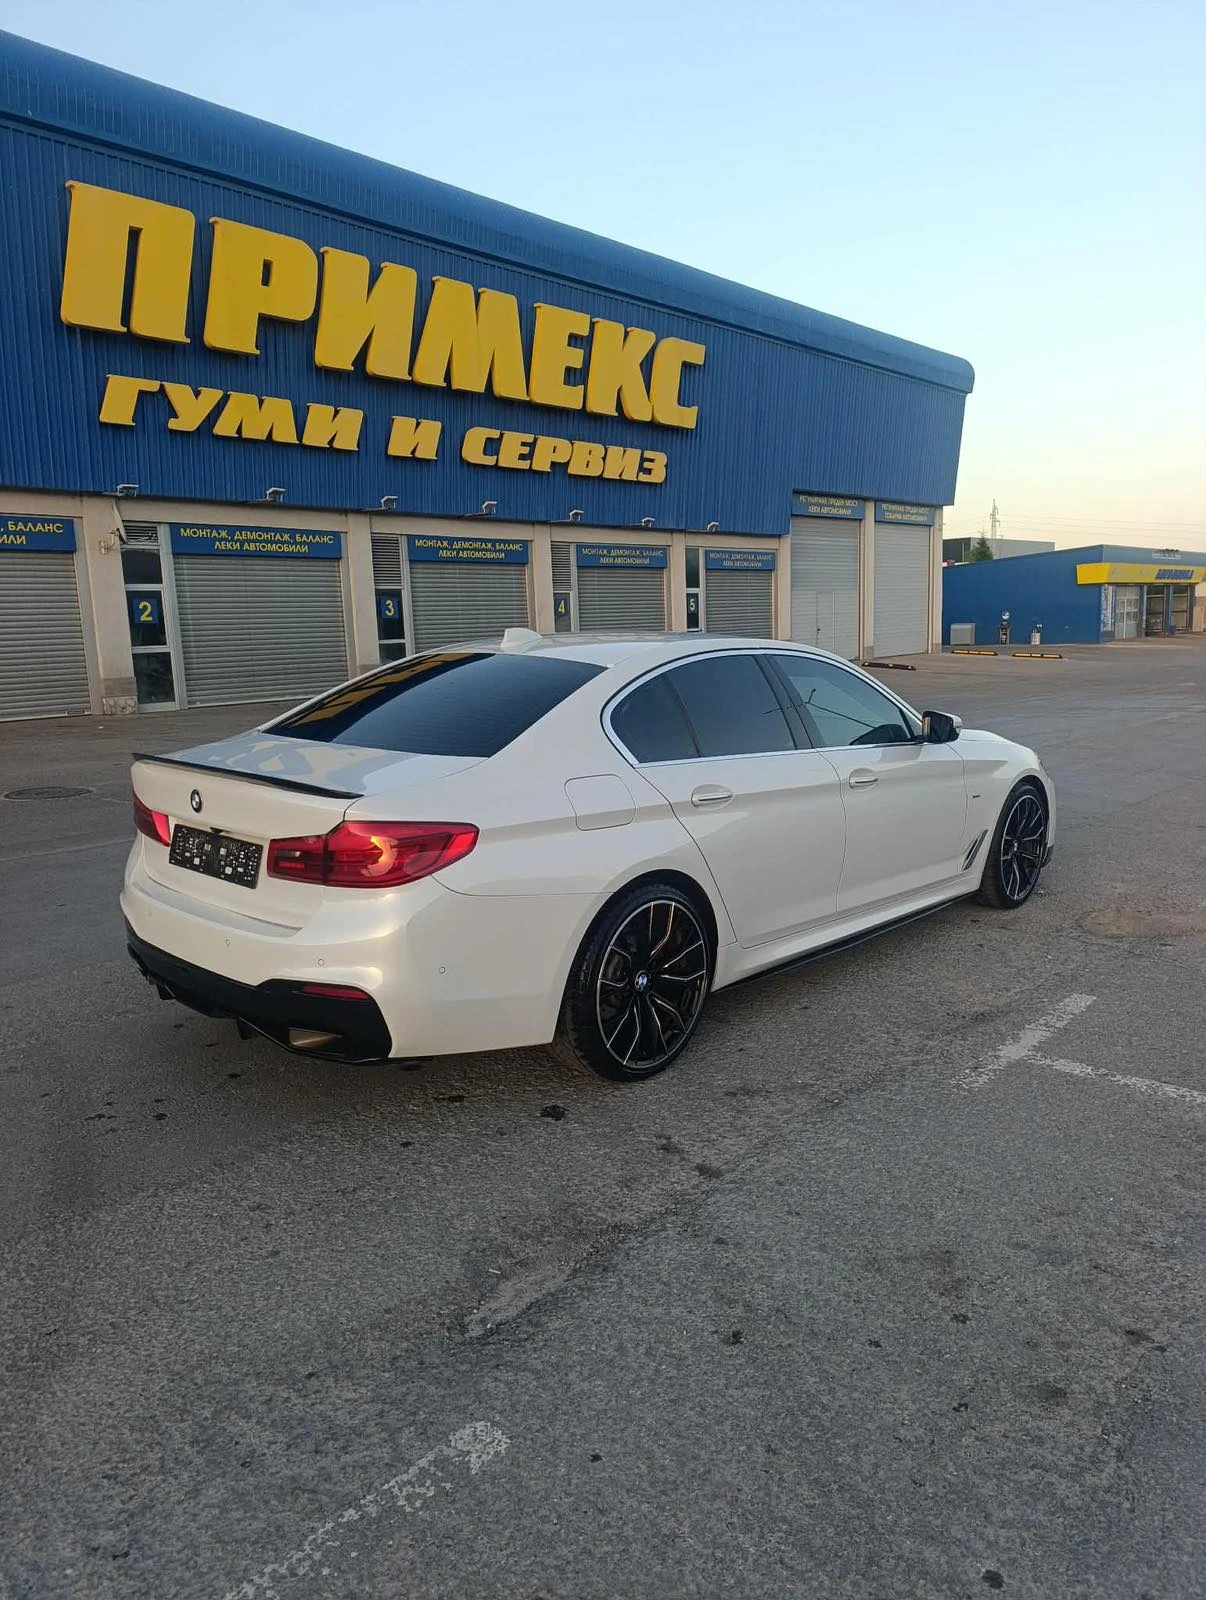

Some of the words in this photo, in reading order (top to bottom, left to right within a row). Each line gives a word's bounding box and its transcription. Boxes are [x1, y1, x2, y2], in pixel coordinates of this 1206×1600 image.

[60, 180, 705, 429] ПРИМЕКС
[99, 374, 363, 451] ГУМИ
[387, 415, 441, 460] И
[461, 426, 667, 483] СЕРВИЗ
[7, 521, 64, 533] БАЛАНС
[180, 528, 232, 540] МОНТАЖ,
[234, 530, 294, 543] ДЕМОНТАЖ,
[295, 533, 335, 544] БАЛАНС
[214, 541, 241, 550] ЛЕКИ
[243, 542, 309, 553] АВТОМОБИЛИ
[415, 539, 451, 549] МОНТАЖ,
[452, 541, 495, 551] ДЕМОНТАЖ,
[495, 543, 524, 551] БАЛАНС
[438, 549, 457, 558] ЛЕКИ
[458, 550, 505, 559] АВТОМОБИЛИ
[139, 601, 153, 622] 2
[386, 600, 395, 616] 3
[558, 600, 566, 614] 4
[690, 599, 696, 611] 5
